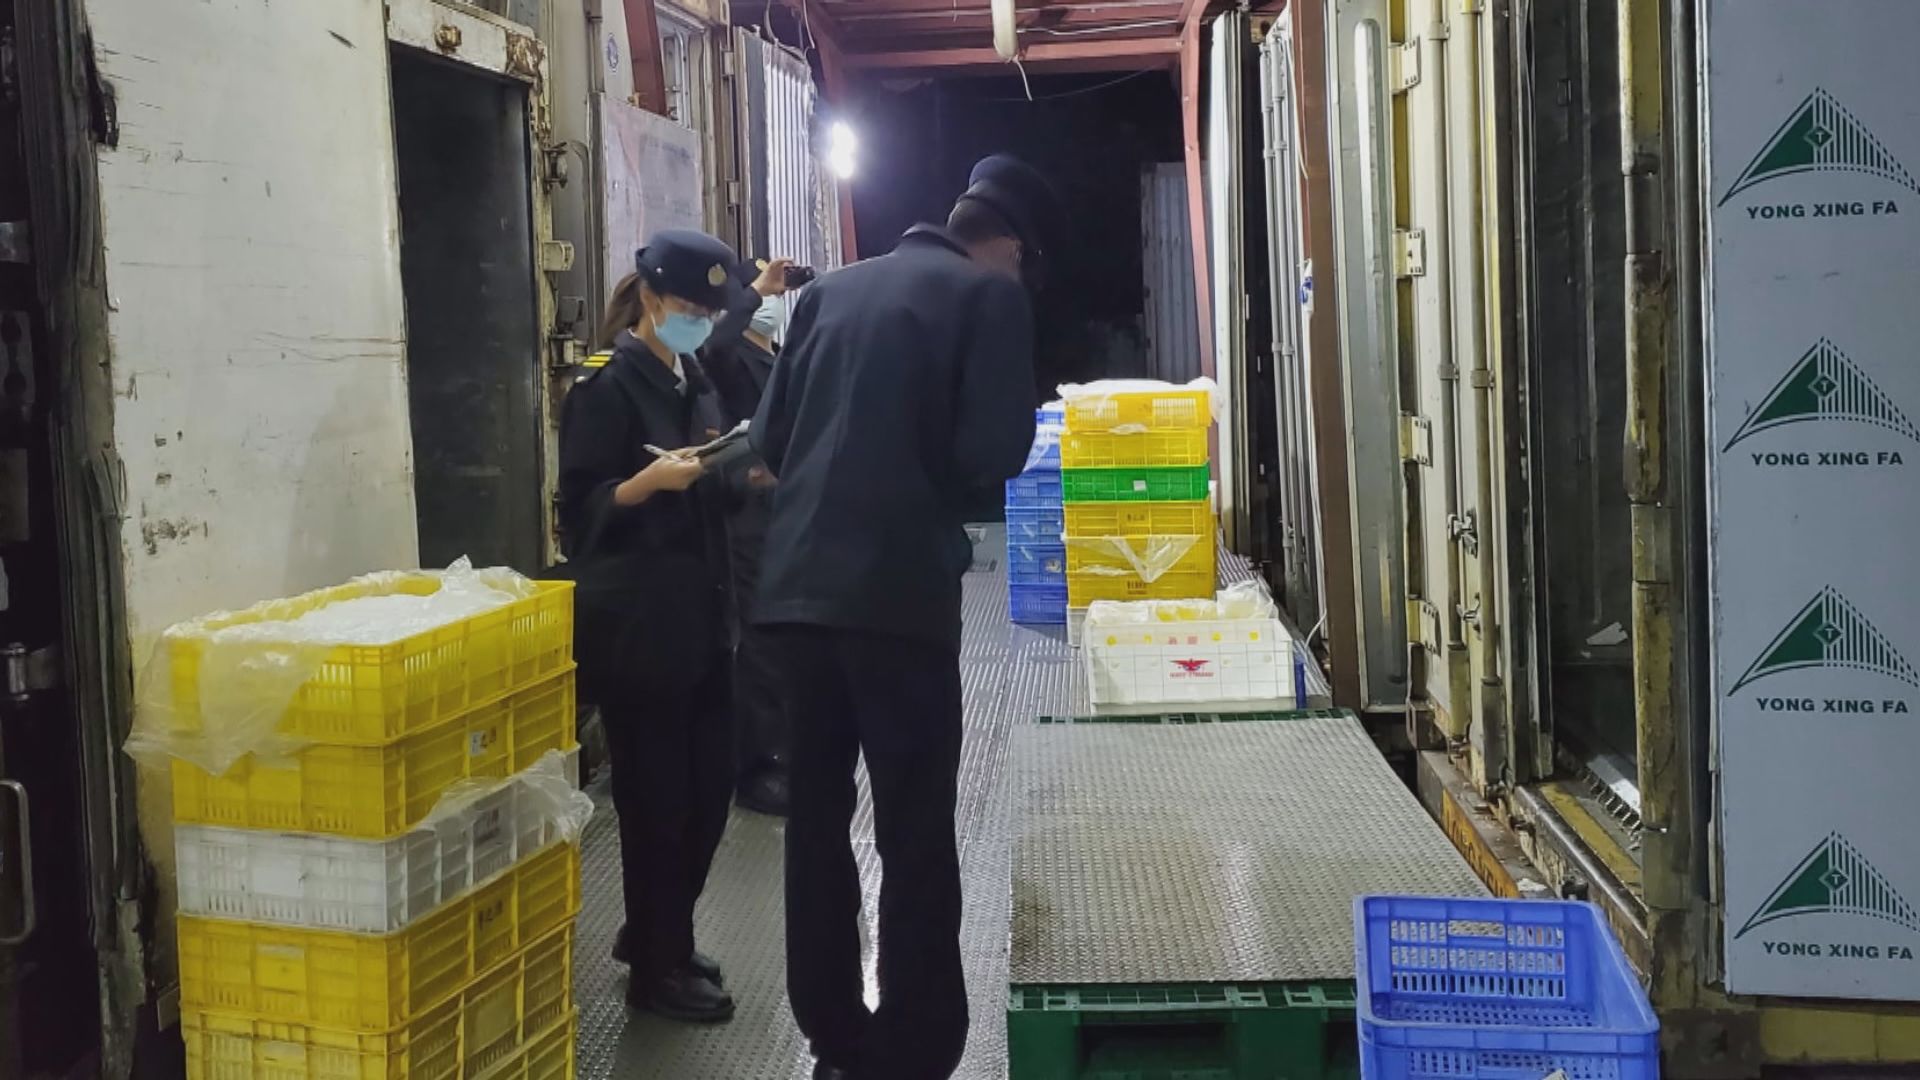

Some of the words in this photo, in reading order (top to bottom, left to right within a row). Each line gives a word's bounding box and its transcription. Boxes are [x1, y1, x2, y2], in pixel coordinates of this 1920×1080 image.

[1746, 204, 1805, 219] YONG
[1813, 202, 1865, 217] XING
[1872, 200, 1899, 215] FA
[1751, 452, 1810, 466] YONG
[1817, 452, 1870, 466] XING
[1877, 451, 1903, 466] FA
[1756, 697, 1815, 712] YONG
[1823, 699, 1875, 713] XING
[1883, 699, 1909, 714] FA
[1763, 941, 1821, 956] YONG
[1829, 943, 1880, 959] XING
[1888, 945, 1914, 960] FA
